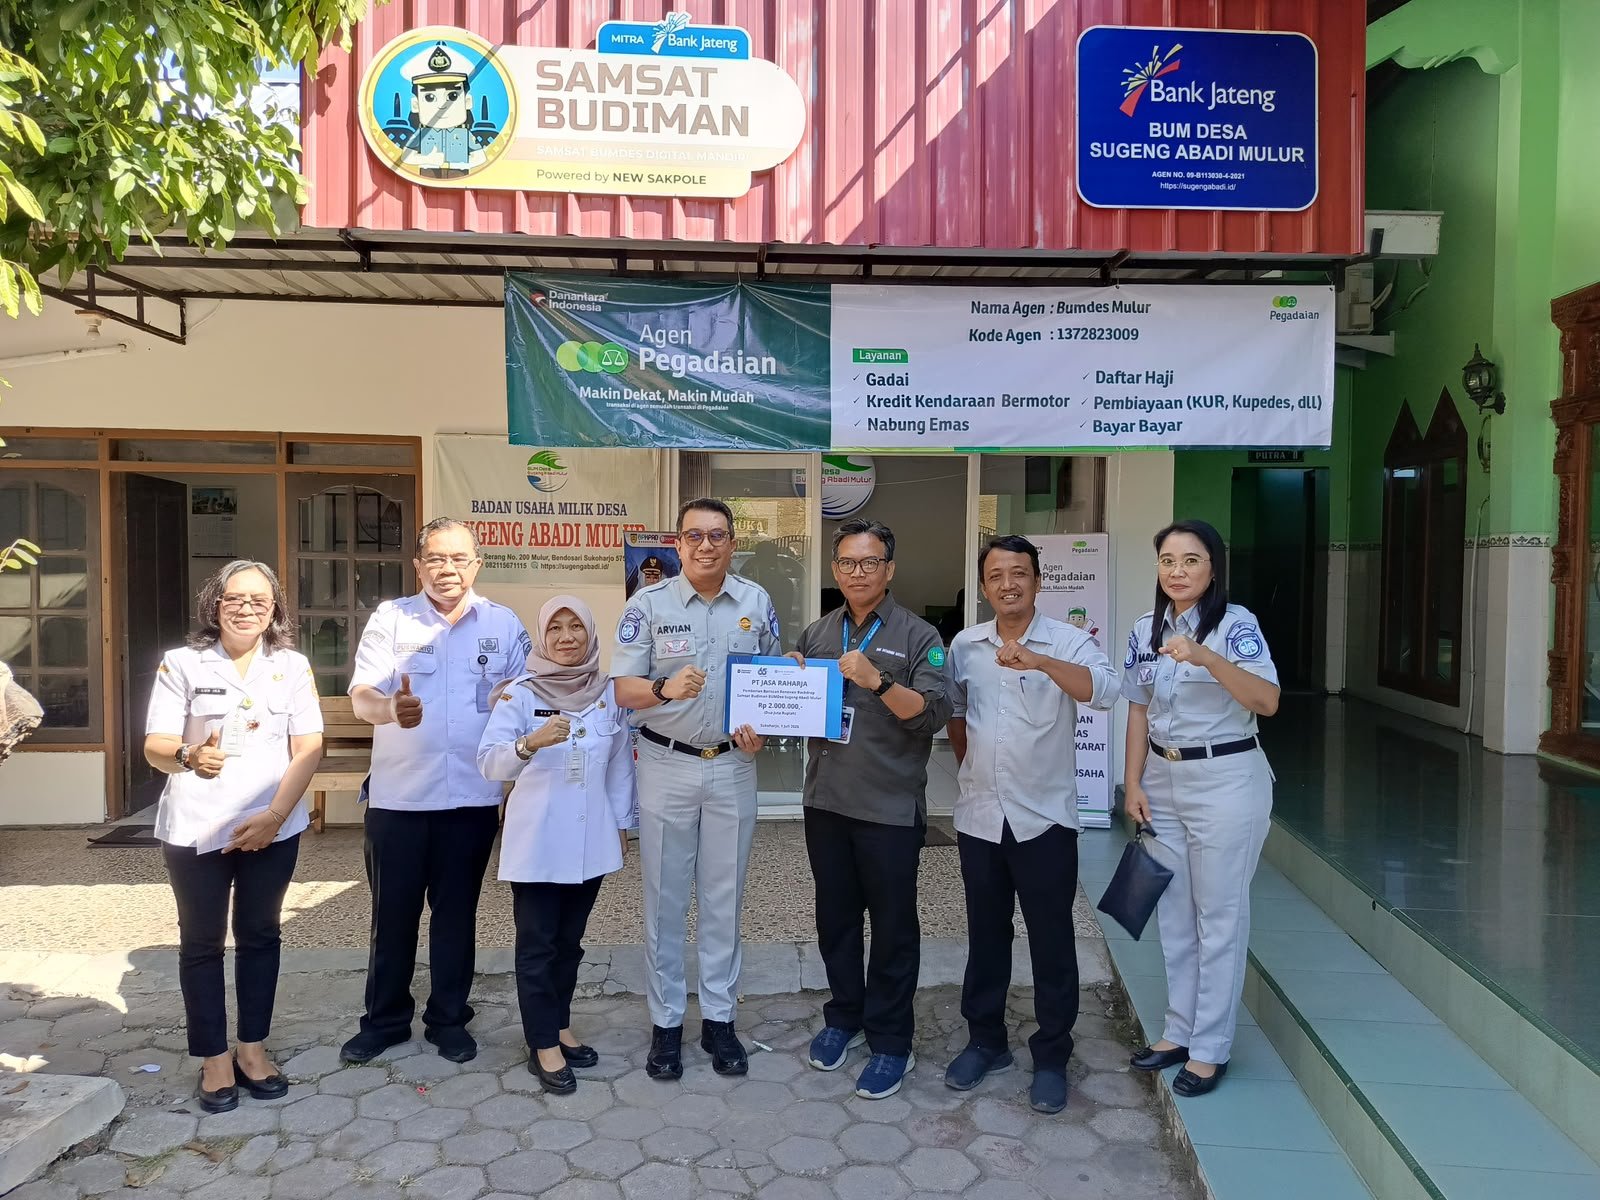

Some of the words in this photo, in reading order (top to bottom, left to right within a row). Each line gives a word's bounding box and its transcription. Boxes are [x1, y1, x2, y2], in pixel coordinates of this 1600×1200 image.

[611, 34, 644, 44] MITRA
[668, 34, 698, 48] Bank
[700, 35, 738, 52] Jateng
[536, 60, 718, 98] SAMSAT
[1150, 79, 1204, 104] Bank
[1208, 82, 1276, 112] Jateng
[537, 97, 749, 137] BUDIMAN
[1149, 122, 1190, 138] BUM
[1196, 124, 1248, 140] DESA
[536, 145, 585, 156] SAMSAT
[1090, 142, 1170, 160] SUGENG
[1174, 144, 1233, 161] ABADI
[1238, 146, 1304, 163] MULUR
[536, 169, 591, 181] Powered
[594, 170, 609, 184] by
[612, 172, 644, 183] NEW
[648, 174, 707, 185] SAKPOLE
[1160, 182, 1236, 191] https://sugengabadi.id/
[548, 290, 605, 302] Danantara
[548, 300, 602, 312] Indonesia
[970, 300, 1010, 315] Nama
[1012, 301, 1045, 318] Agen
[1056, 300, 1110, 315] Bumdes
[1112, 300, 1152, 314] Mulur
[1270, 310, 1320, 322] Pegadaian
[640, 324, 692, 348] Agen
[968, 328, 1003, 342] Kode
[1005, 328, 1042, 344] Agen
[1057, 328, 1140, 341] 1372823009
[639, 347, 777, 378] Pegadaian
[858, 350, 902, 362] Layanan
[866, 372, 910, 386] Gadai
[1095, 370, 1142, 384] Daftar
[1145, 370, 1174, 388] Haji
[579, 386, 621, 400] Makin
[623, 388, 665, 404] Dekat,
[668, 389, 708, 402] Makin
[710, 390, 754, 404] Mudah
[866, 394, 912, 408] Kredit
[914, 394, 996, 408] Kendaraan
[1001, 394, 1070, 408] Bermotor
[1094, 396, 1183, 413] Pembiayaan
[1186, 394, 1228, 411] (KUR,
[1232, 394, 1294, 411] Kupedes,
[1298, 395, 1322, 411] dll)
[867, 418, 926, 435] Nabung
[929, 418, 970, 432] Emas
[1092, 420, 1136, 436] Bayar
[1139, 419, 1183, 435] Bayar
[1256, 452, 1286, 460] PUTRA
[472, 500, 512, 514] BADAN
[516, 502, 554, 515] USAHA
[558, 502, 594, 516] MILIK
[596, 503, 627, 516] DESA
[528, 522, 581, 548] ABADI
[586, 523, 646, 548] MUL
[484, 553, 506, 562] Serang
[531, 554, 550, 562] Mulur,
[552, 554, 582, 562] Bendosari
[584, 555, 614, 564] Sukoharjo
[1042, 564, 1062, 572] Agen
[1042, 572, 1096, 584] Pegadaian
[656, 624, 692, 635] ARVIAN
[1075, 743, 1106, 751] KARAT
